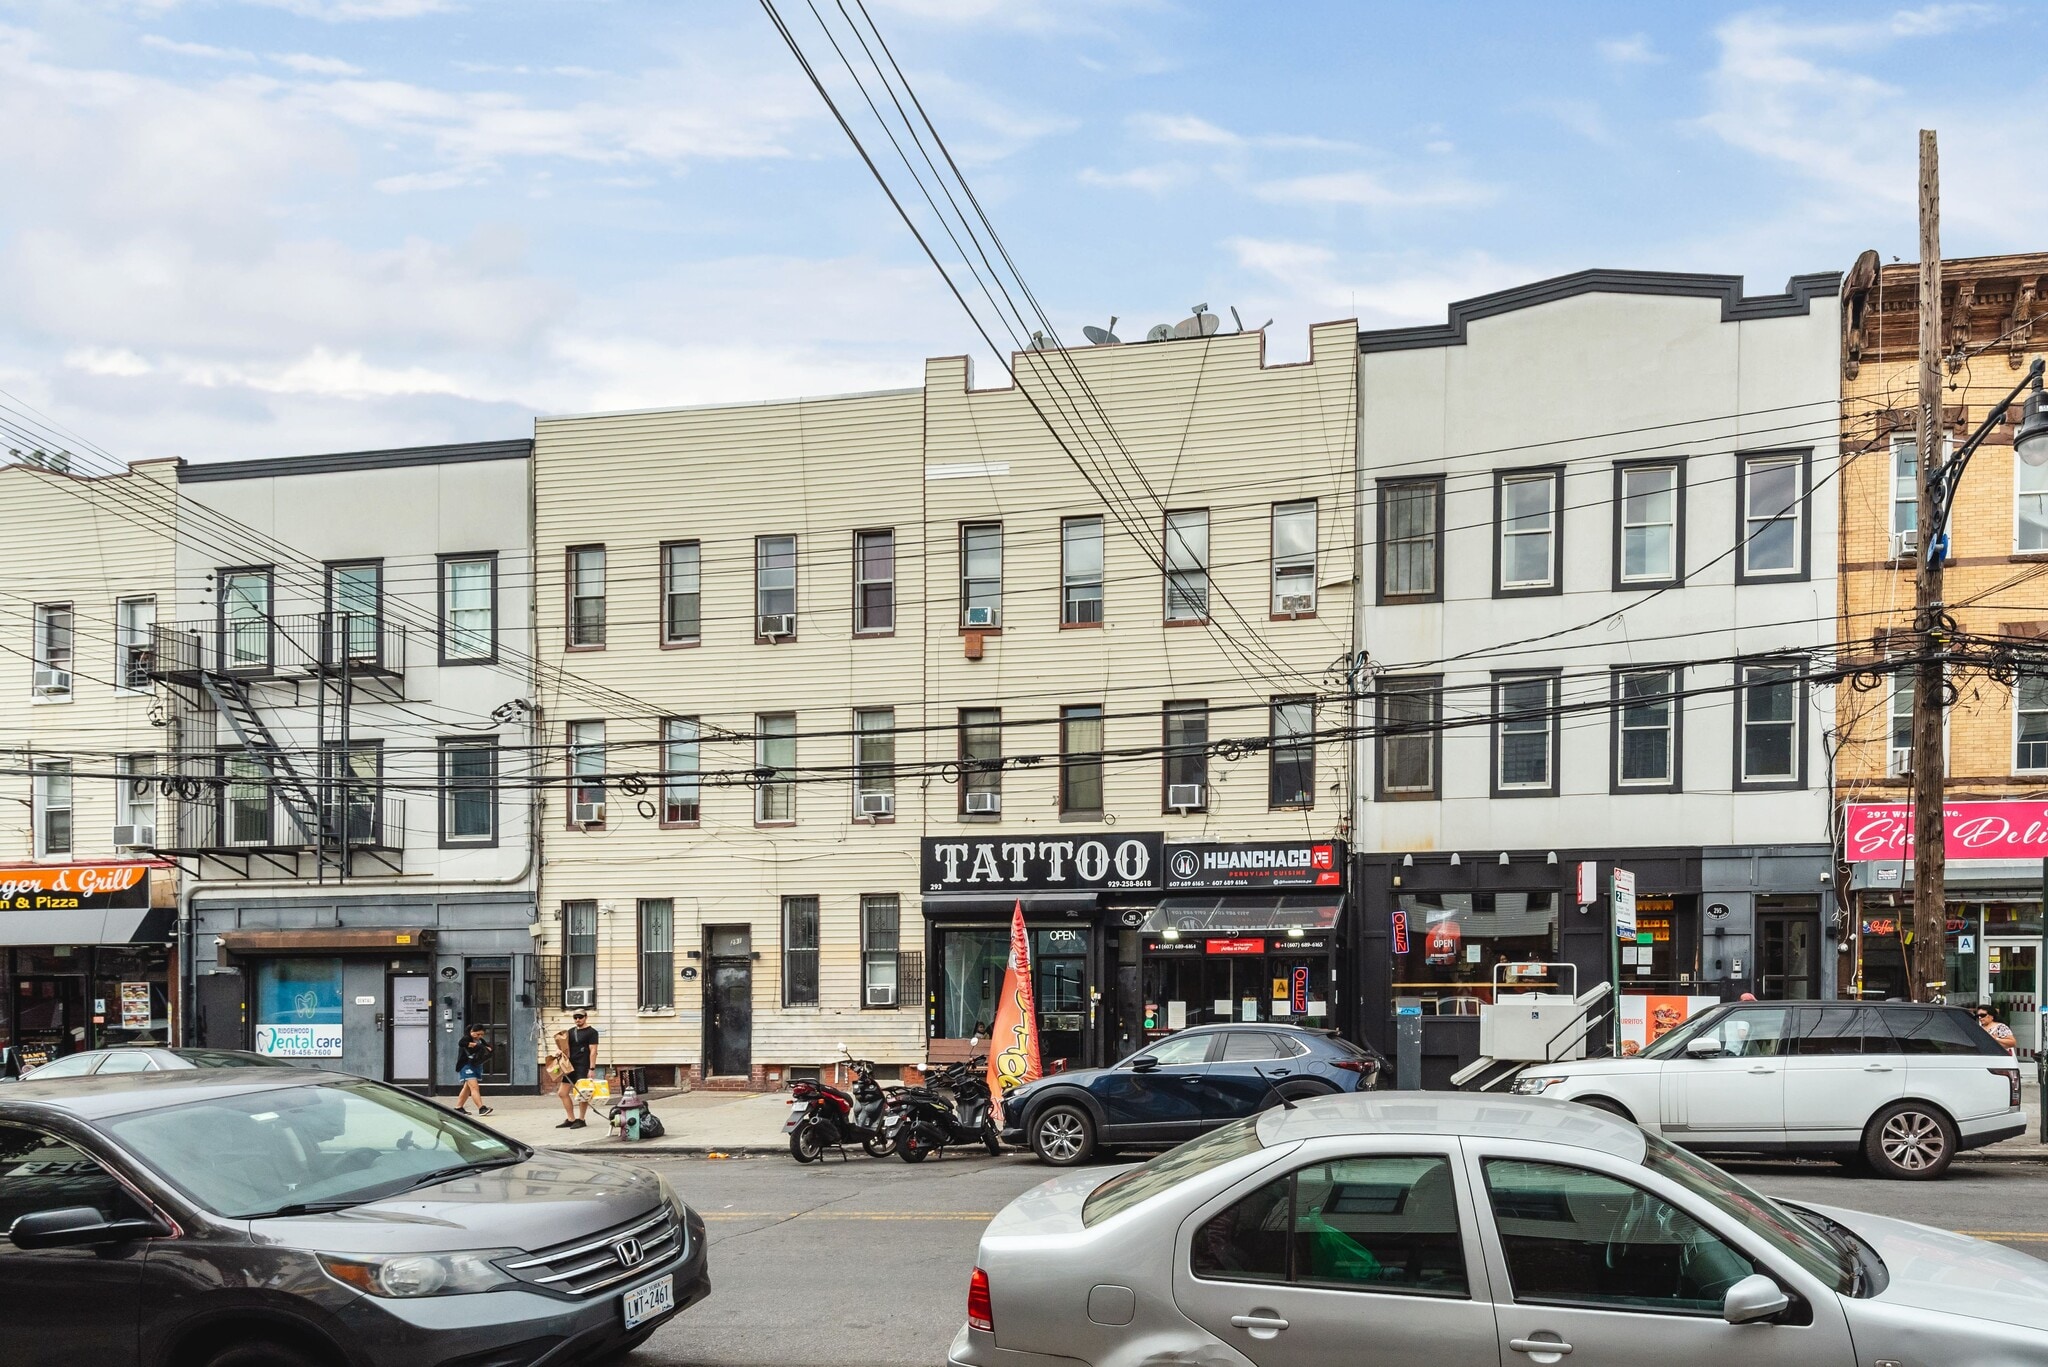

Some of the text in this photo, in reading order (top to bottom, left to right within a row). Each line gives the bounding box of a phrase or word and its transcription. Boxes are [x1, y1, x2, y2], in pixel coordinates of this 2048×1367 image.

[1867, 810, 1888, 818] 297
[1892, 809, 1915, 818] Wyc
[1854, 816, 2048, 853] Sta Deli
[934, 839, 1150, 883] TATTOO
[1203, 849, 1311, 869] HUANCHACO
[0, 868, 134, 900] ger & Grill
[930, 883, 942, 891] 293
[15, 897, 30, 909] &
[36, 896, 78, 909] Pizza
[1394, 913, 1406, 952] OPEN
[1870, 919, 1894, 935] Coffee
[1049, 930, 1076, 940] OPEN
[1433, 939, 1453, 948] OPEN
[1961, 937, 1971, 949] A
[1276, 982, 1286, 993] A
[1295, 969, 1306, 1010] OPEN
[96, 1000, 103, 1009] A
[316, 1037, 342, 1048] care
[649, 1284, 668, 1309] 2461
